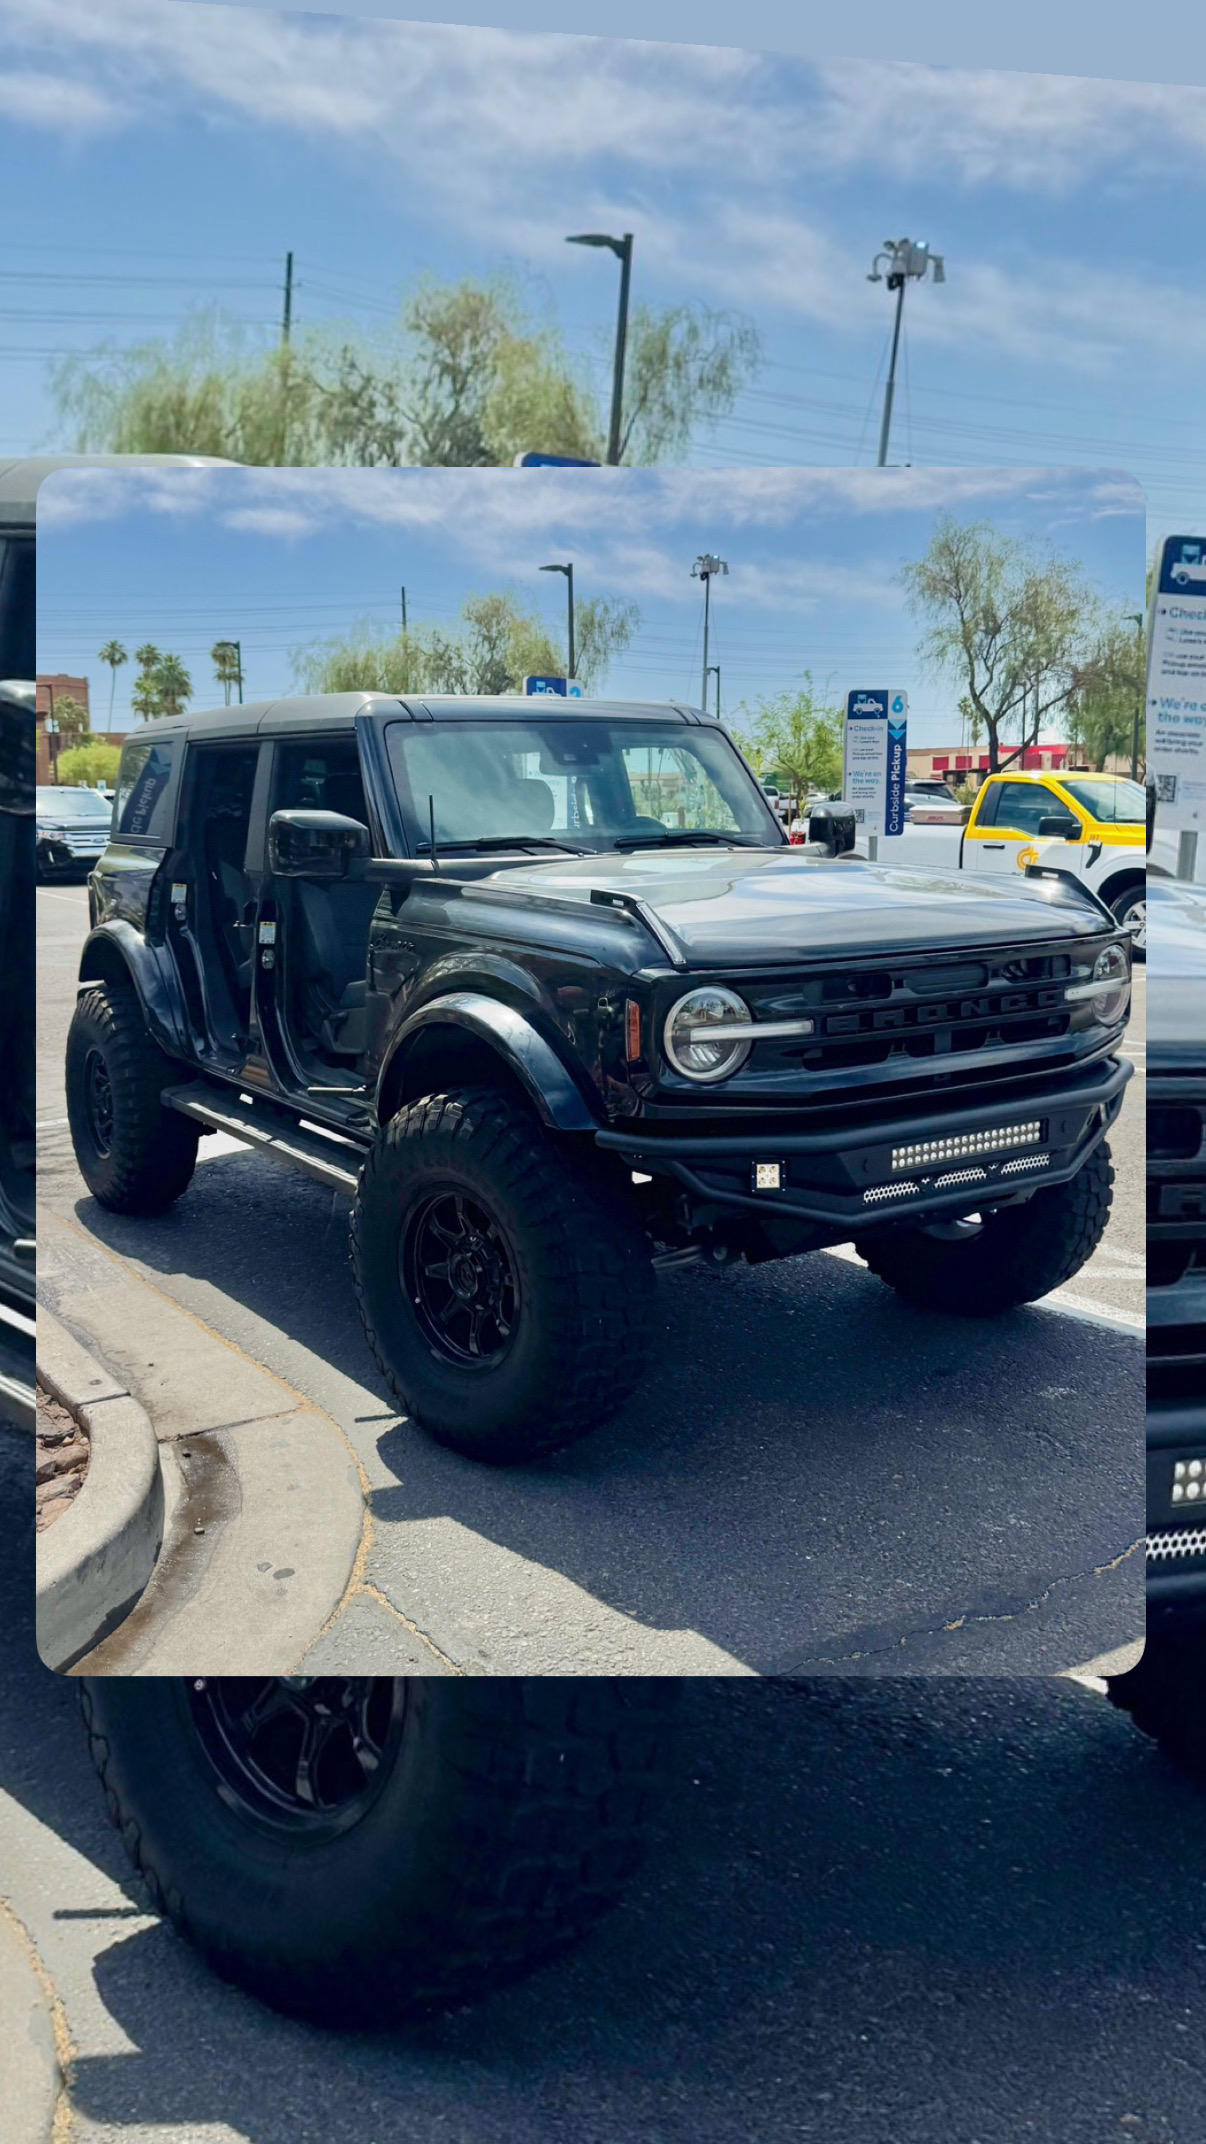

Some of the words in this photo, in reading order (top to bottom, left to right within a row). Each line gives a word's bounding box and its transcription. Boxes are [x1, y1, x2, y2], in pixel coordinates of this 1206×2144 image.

[892, 695, 904, 714] 6
[1158, 713, 1180, 723] the
[1160, 697, 1197, 711] We're
[891, 744, 902, 781] Pickup
[889, 783, 901, 832] Curbside
[826, 990, 1066, 1034] BRONCO
